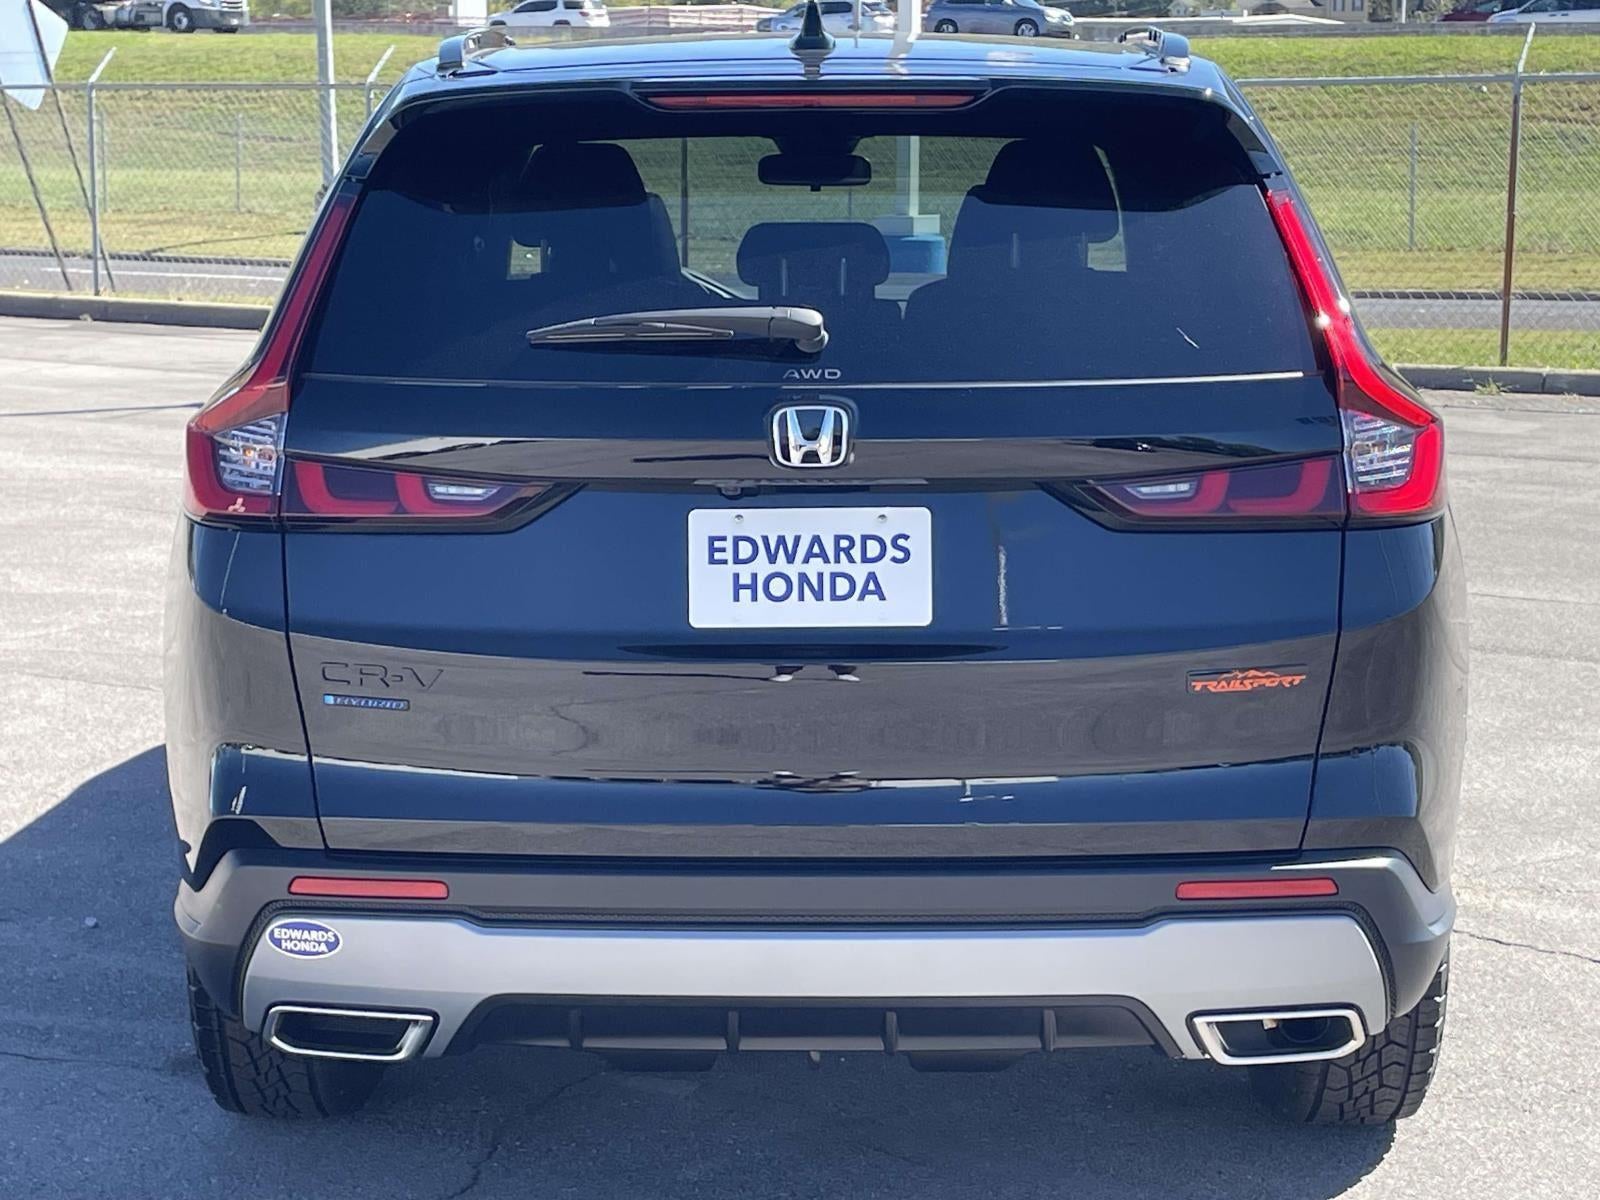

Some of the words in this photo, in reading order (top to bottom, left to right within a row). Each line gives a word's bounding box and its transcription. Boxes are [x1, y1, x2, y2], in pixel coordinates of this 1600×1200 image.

[783, 368, 842, 380] AWD
[707, 533, 911, 565] EDWARDS
[732, 571, 887, 602] HONDA
[321, 661, 444, 690] CR-V
[1191, 673, 1307, 692] TRAILSPORT
[273, 928, 336, 943] EDWARDS
[281, 940, 329, 953] HONDA
